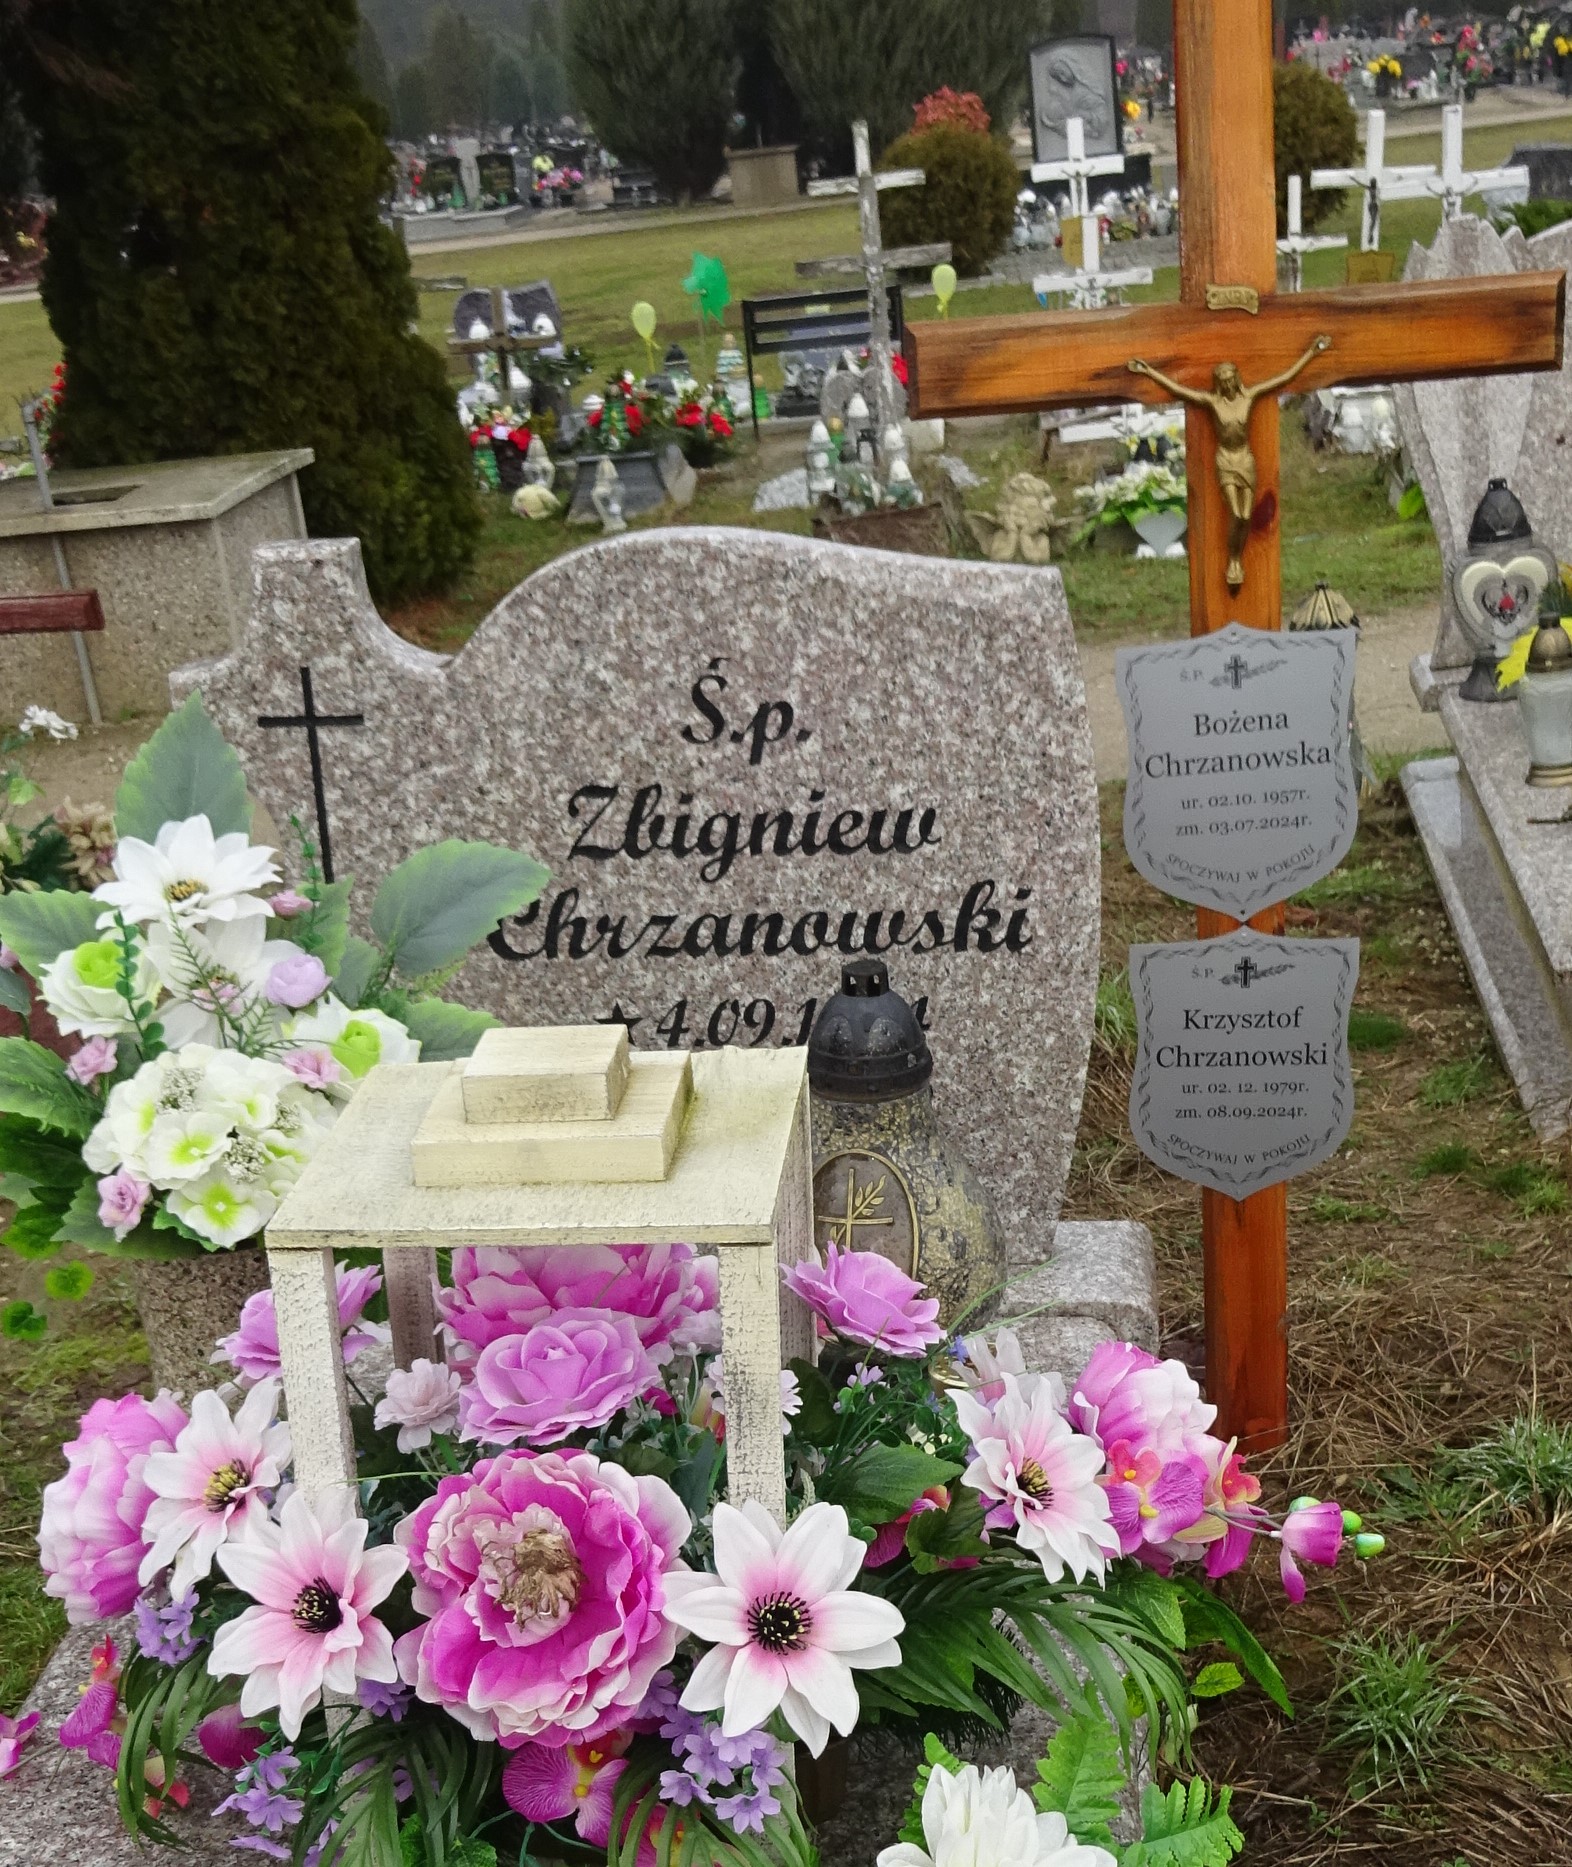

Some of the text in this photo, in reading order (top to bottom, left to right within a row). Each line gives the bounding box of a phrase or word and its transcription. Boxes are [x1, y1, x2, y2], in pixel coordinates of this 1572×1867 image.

[681, 658, 812, 765] Ś.p.
[1194, 710, 1290, 736] Bożena
[1145, 741, 1332, 778] Chrzanowska
[1181, 798, 1203, 809] ur.
[567, 784, 940, 883] Zbigniew
[1176, 815, 1312, 836] zm. 03.07.2024r.
[1166, 843, 1316, 883] SPOCZYWAJ W POKOJU
[487, 880, 1034, 960] Chrzanowski
[1183, 1005, 1304, 1035] Krzysztof
[1156, 1042, 1327, 1069] Chrzanowski
[1181, 1082, 1203, 1094] ur.
[1175, 1104, 1307, 1120] zm. 08.09.2024r.
[1167, 1133, 1310, 1165] SPOCZYWAJ W POKOJU
